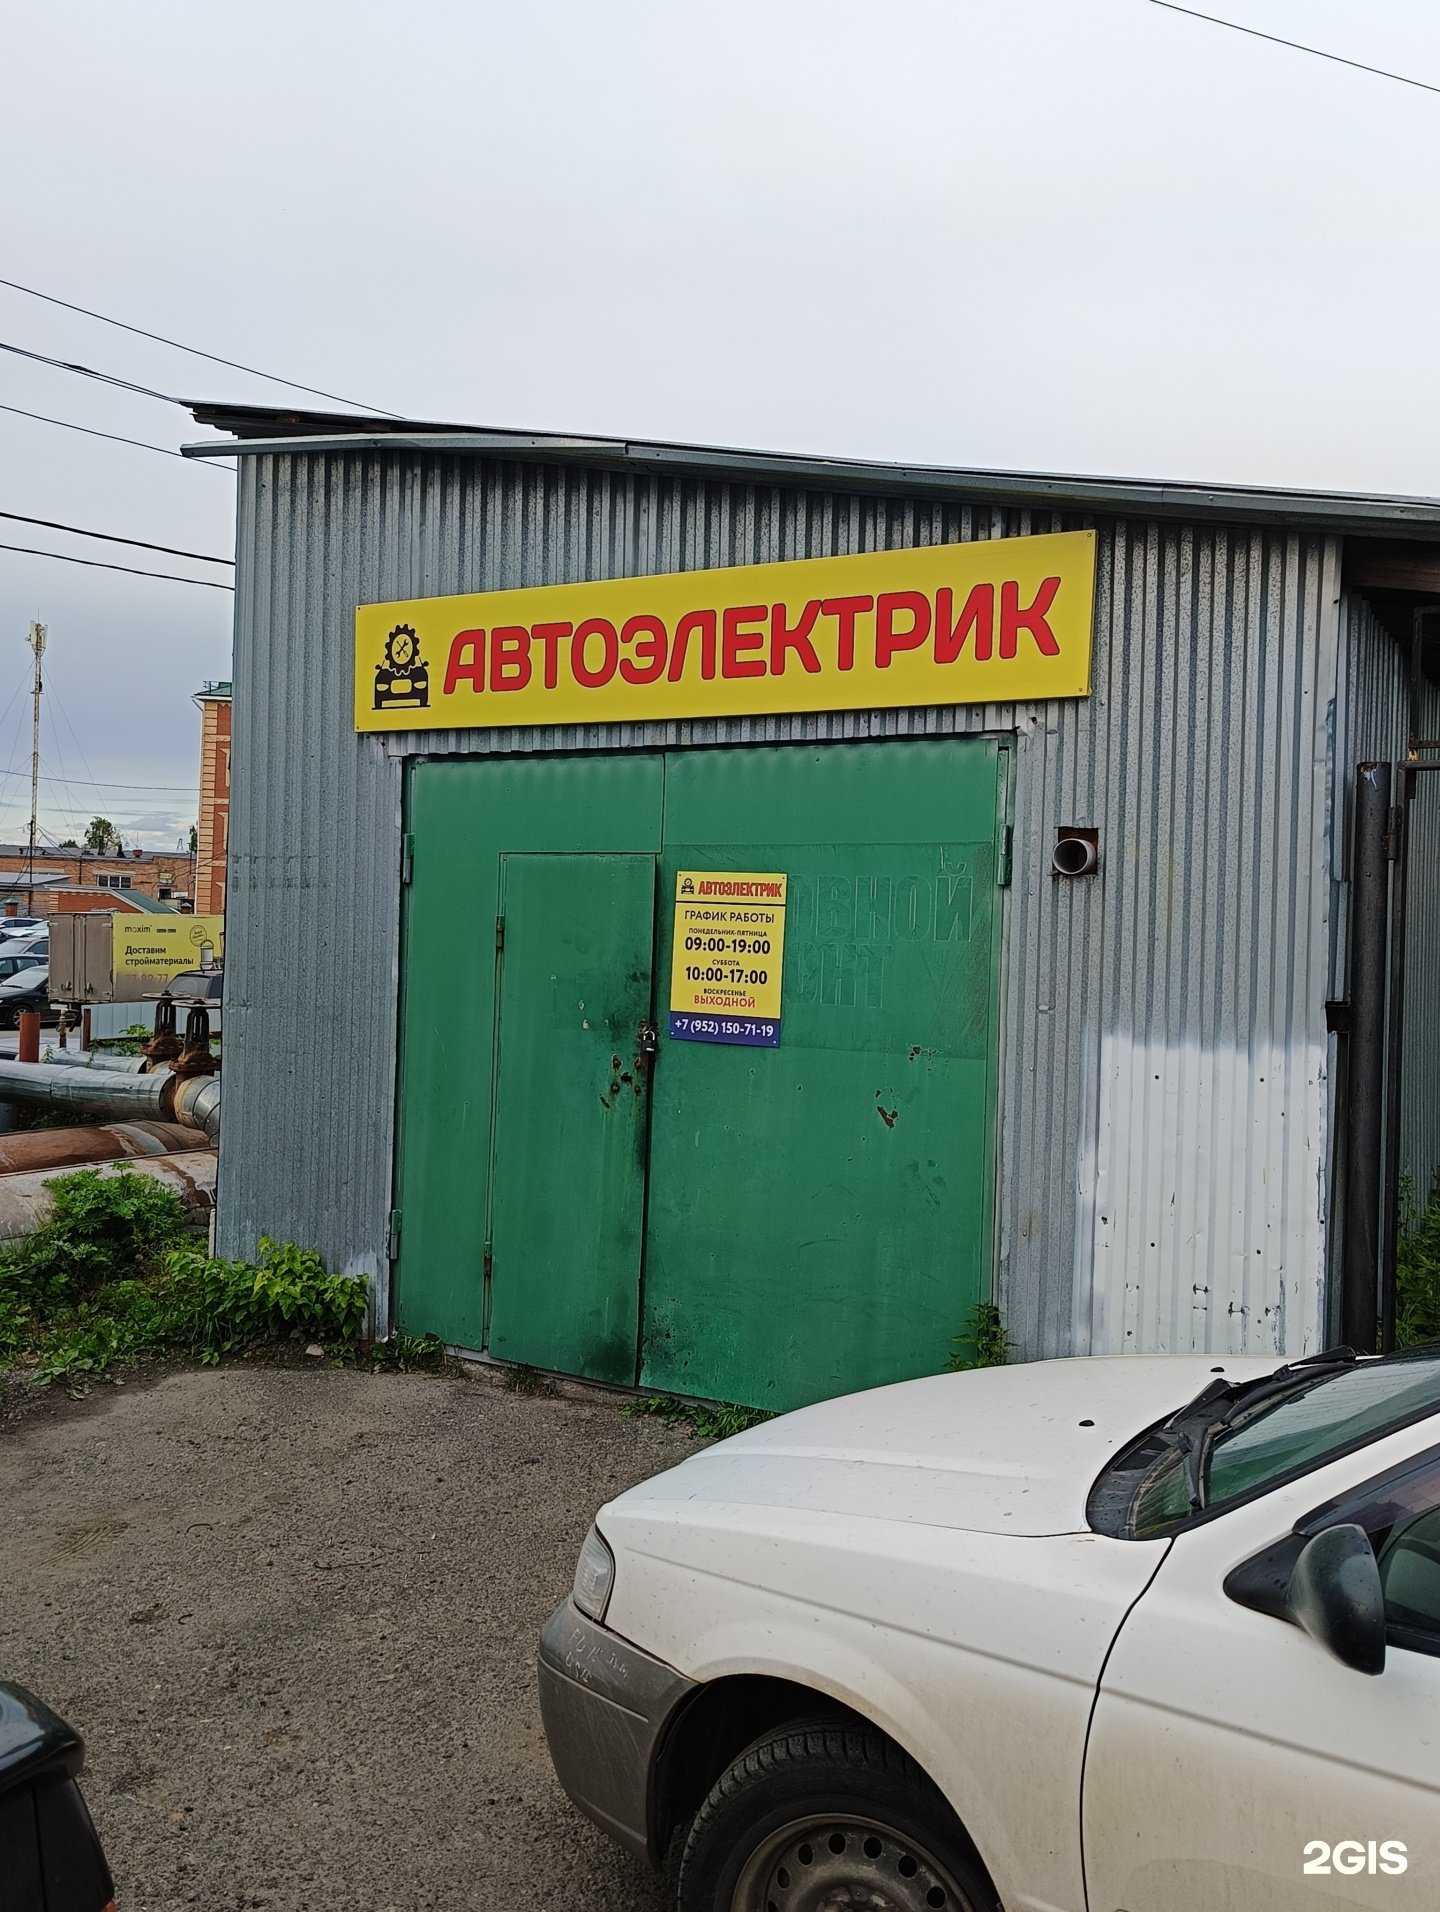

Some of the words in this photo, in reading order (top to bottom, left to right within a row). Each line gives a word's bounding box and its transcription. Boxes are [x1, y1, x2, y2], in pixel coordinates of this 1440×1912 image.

[443, 576, 1061, 695] АВТОЭЛЕКТРИК
[698, 880, 783, 897] АВТОЭЛЕКТРИК
[684, 910, 727, 921] ГРАФИК
[730, 912, 775, 923] РАБОТЫ
[688, 927, 767, 937] ПОНЕДЕЛЬНИК-ПЯТНИЦА
[125, 946, 166, 955] Доставим
[685, 936, 771, 955] 09:00-19:00
[125, 957, 194, 967] стройматериалы
[685, 966, 768, 985] 10:00-17:00
[703, 988, 747, 997] ВОСКРЕСЕНЬЕ
[694, 995, 756, 1009] ВЫХОДНОЙ
[675, 1018, 689, 1030] +7
[690, 1020, 719, 1035] (952)
[721, 1022, 774, 1037] 150-71-19
